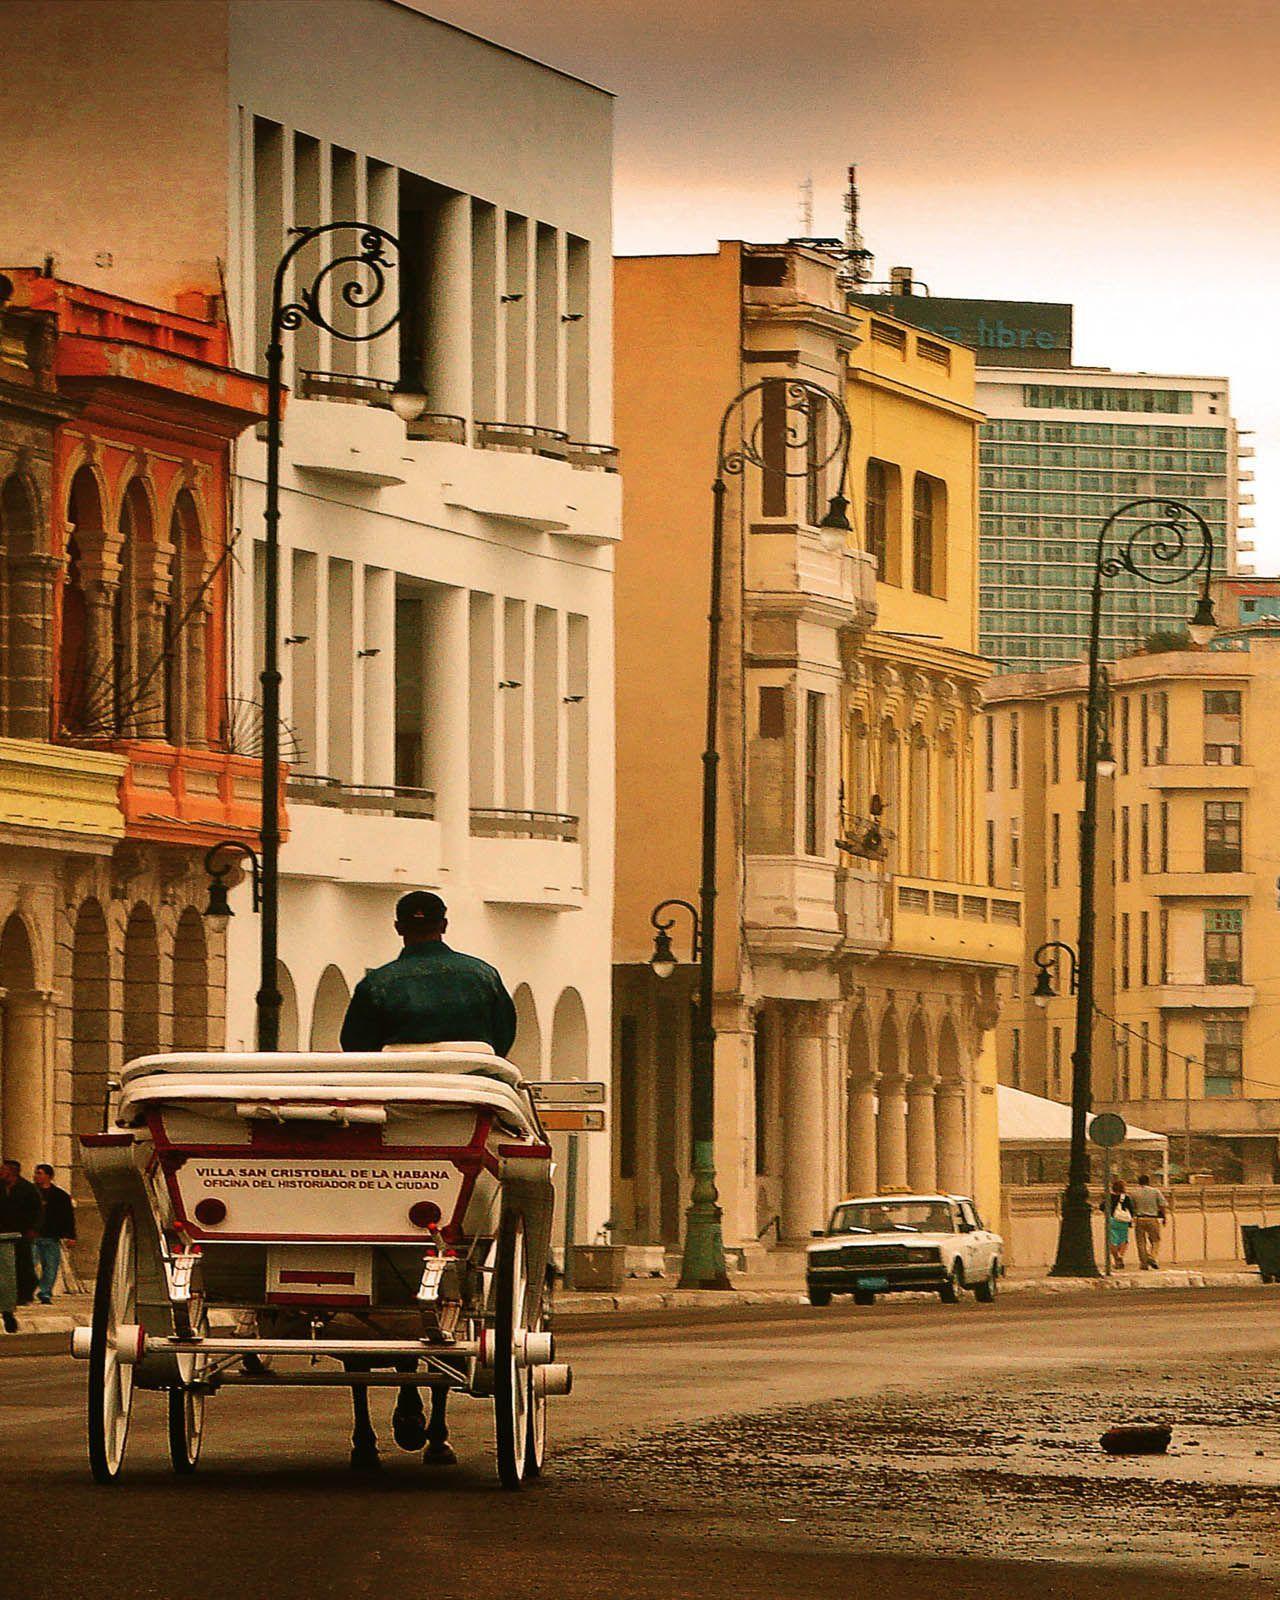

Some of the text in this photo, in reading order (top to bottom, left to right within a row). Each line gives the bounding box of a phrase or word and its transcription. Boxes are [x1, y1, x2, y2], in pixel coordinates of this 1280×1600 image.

[978, 319, 1056, 348] libre
[196, 1168, 450, 1180] VILLA SAN CRISTOBAL DE LA HABANA
[203, 1179, 439, 1190] OFICINA DEL HISTORIADOR DE LA CIUDAD
